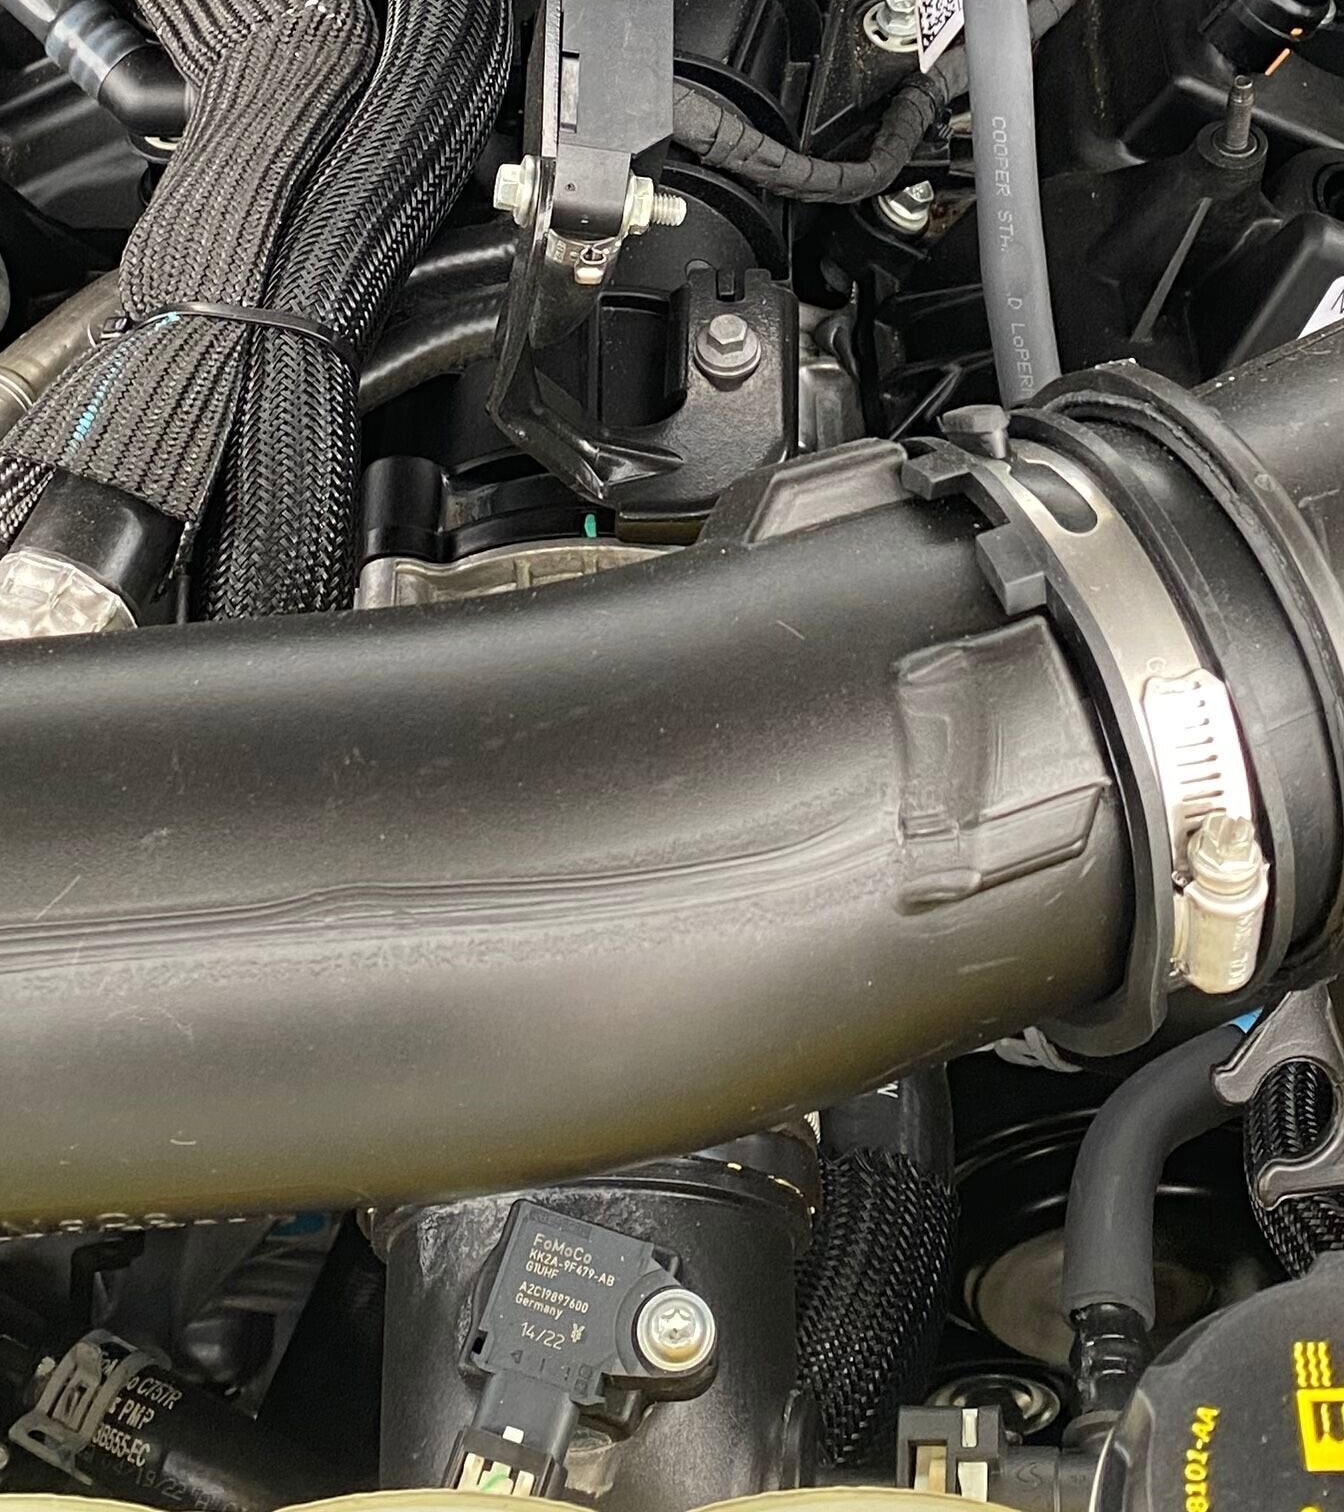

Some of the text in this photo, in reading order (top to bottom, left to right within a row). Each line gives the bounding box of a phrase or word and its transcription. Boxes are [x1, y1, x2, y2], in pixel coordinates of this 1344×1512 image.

[992, 117, 1010, 197] COOPER
[533, 1232, 593, 1265] FoMoCo
[526, 1261, 559, 1280] G1UHF
[528, 1248, 616, 1287] KK2A-9F479-AB
[515, 1292, 563, 1321] Germany
[519, 1280, 589, 1314] A2C19897600
[520, 1321, 565, 1351] 14/22
[136, 1376, 183, 1411] C757R
